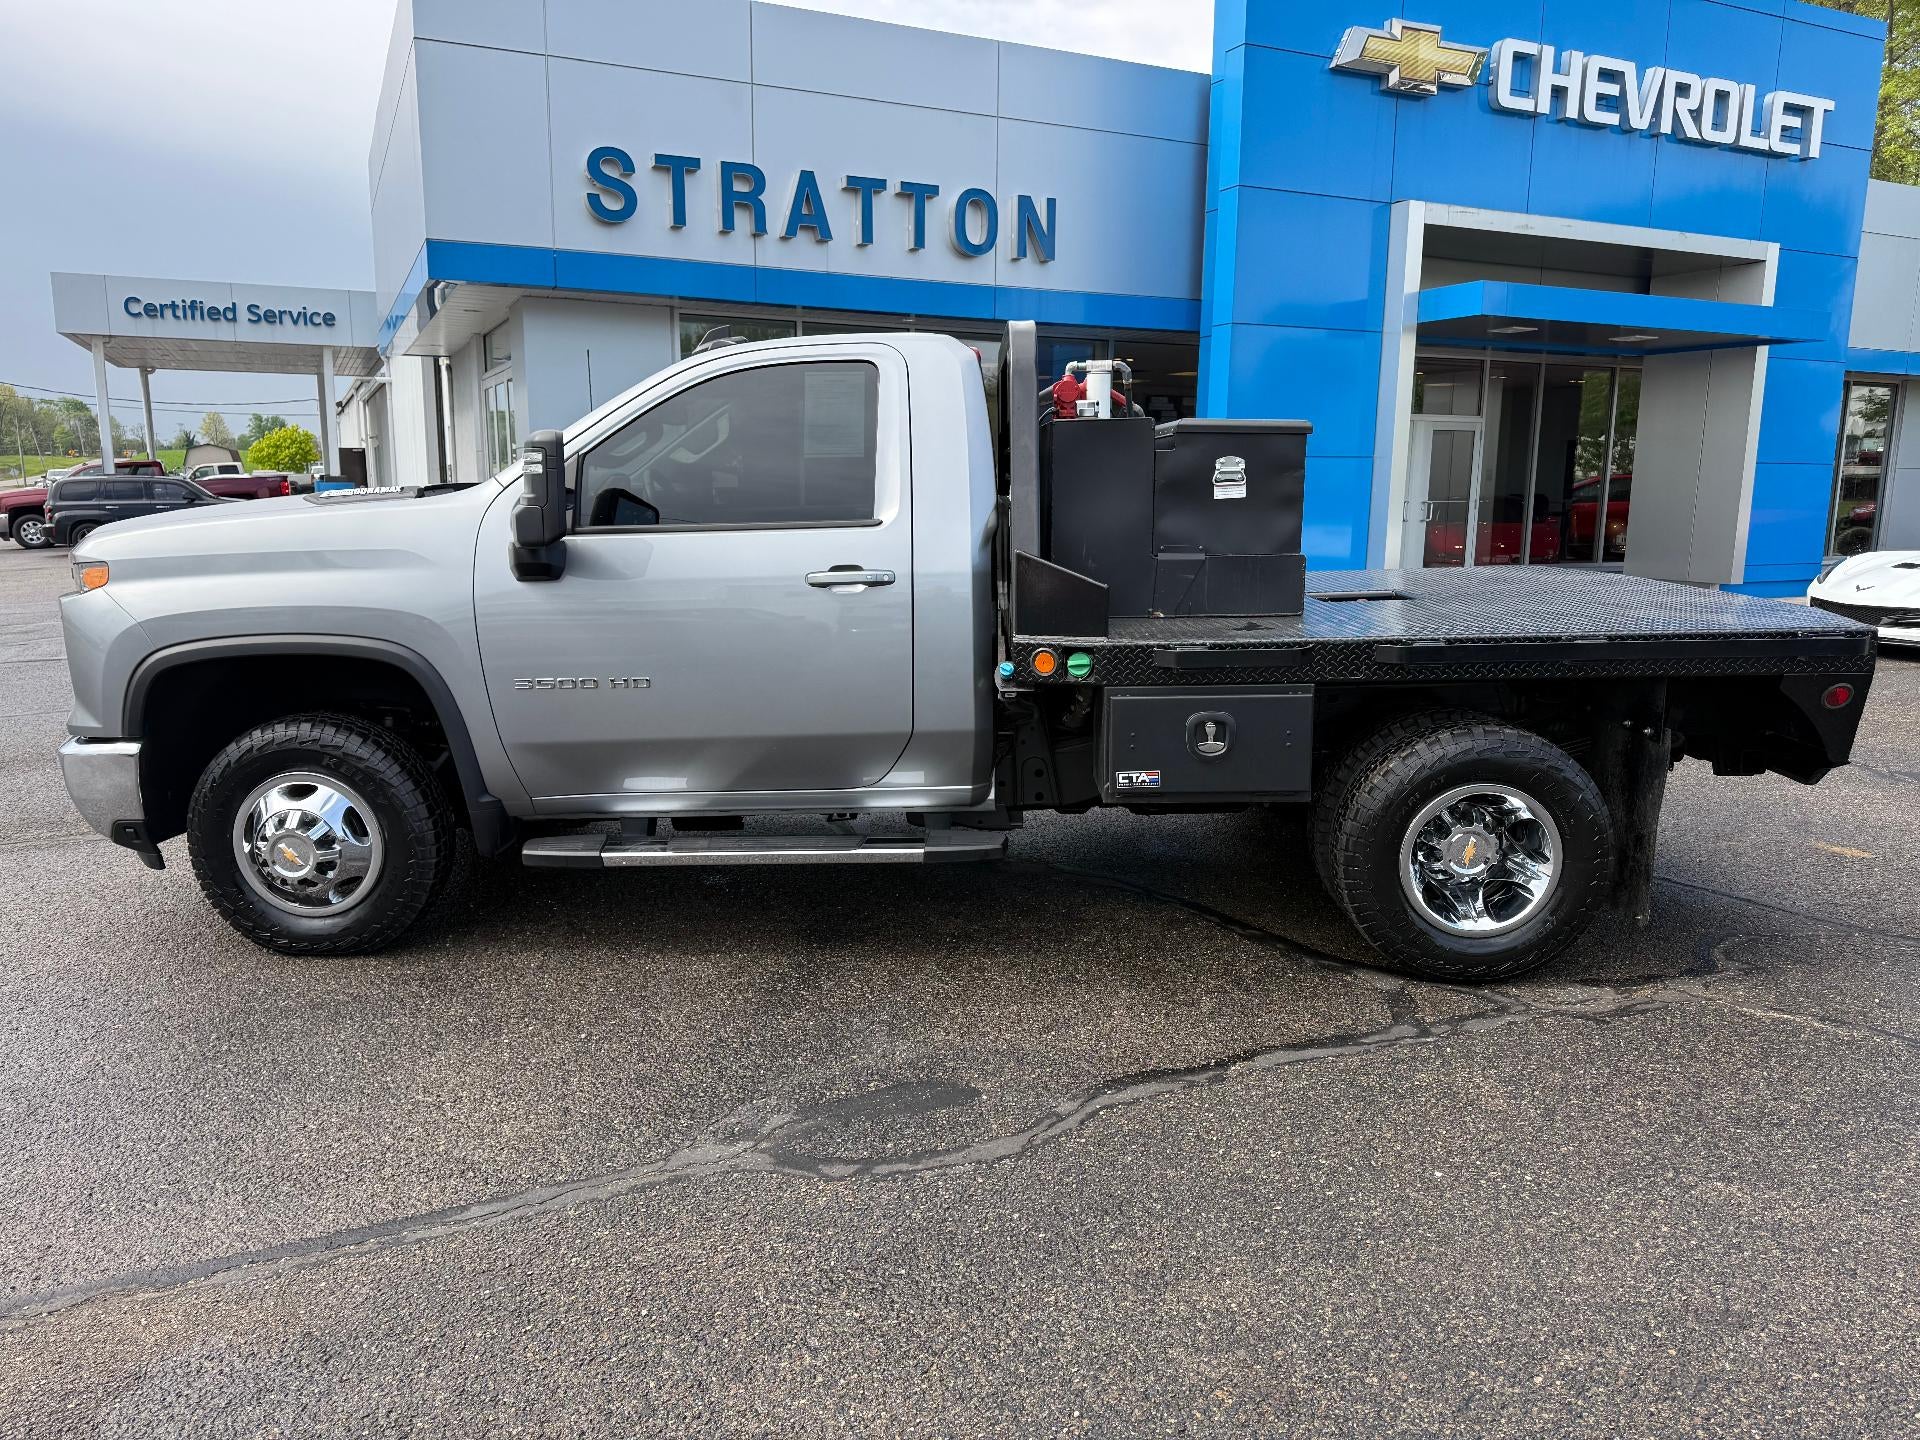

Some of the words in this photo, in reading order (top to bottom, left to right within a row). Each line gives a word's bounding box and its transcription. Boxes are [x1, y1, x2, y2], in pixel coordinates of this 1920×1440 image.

[1489, 37, 1835, 160] CHEVROLET
[584, 146, 1057, 264] STRATTON
[123, 296, 238, 322] Certified
[246, 304, 336, 327] Service
[513, 677, 599, 689] 3500
[608, 677, 651, 689] HD
[1118, 772, 1150, 784] CTA
